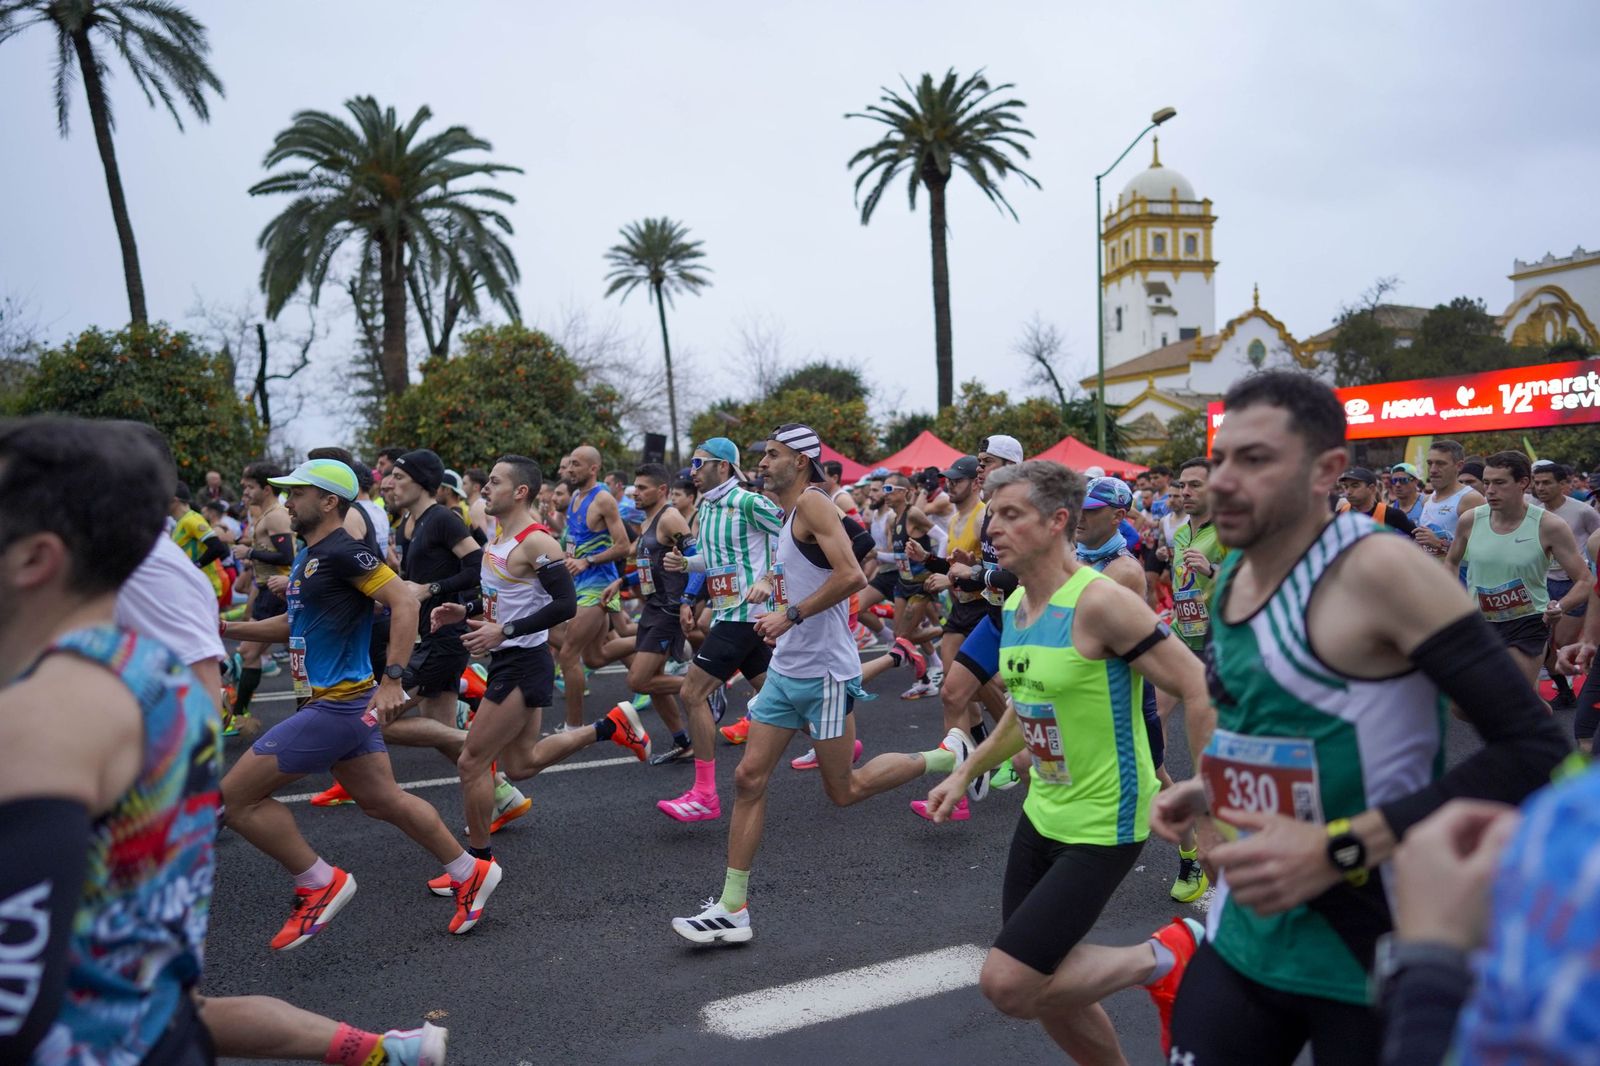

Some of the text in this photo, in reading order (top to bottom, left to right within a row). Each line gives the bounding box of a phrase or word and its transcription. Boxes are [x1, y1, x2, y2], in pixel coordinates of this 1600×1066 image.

[1525, 371, 1600, 396] marat
[1381, 397, 1436, 419] HOKA
[712, 577, 727, 592] 434
[1485, 590, 1519, 607] 1204
[1176, 601, 1198, 617] 1168
[1223, 767, 1279, 816] 330
